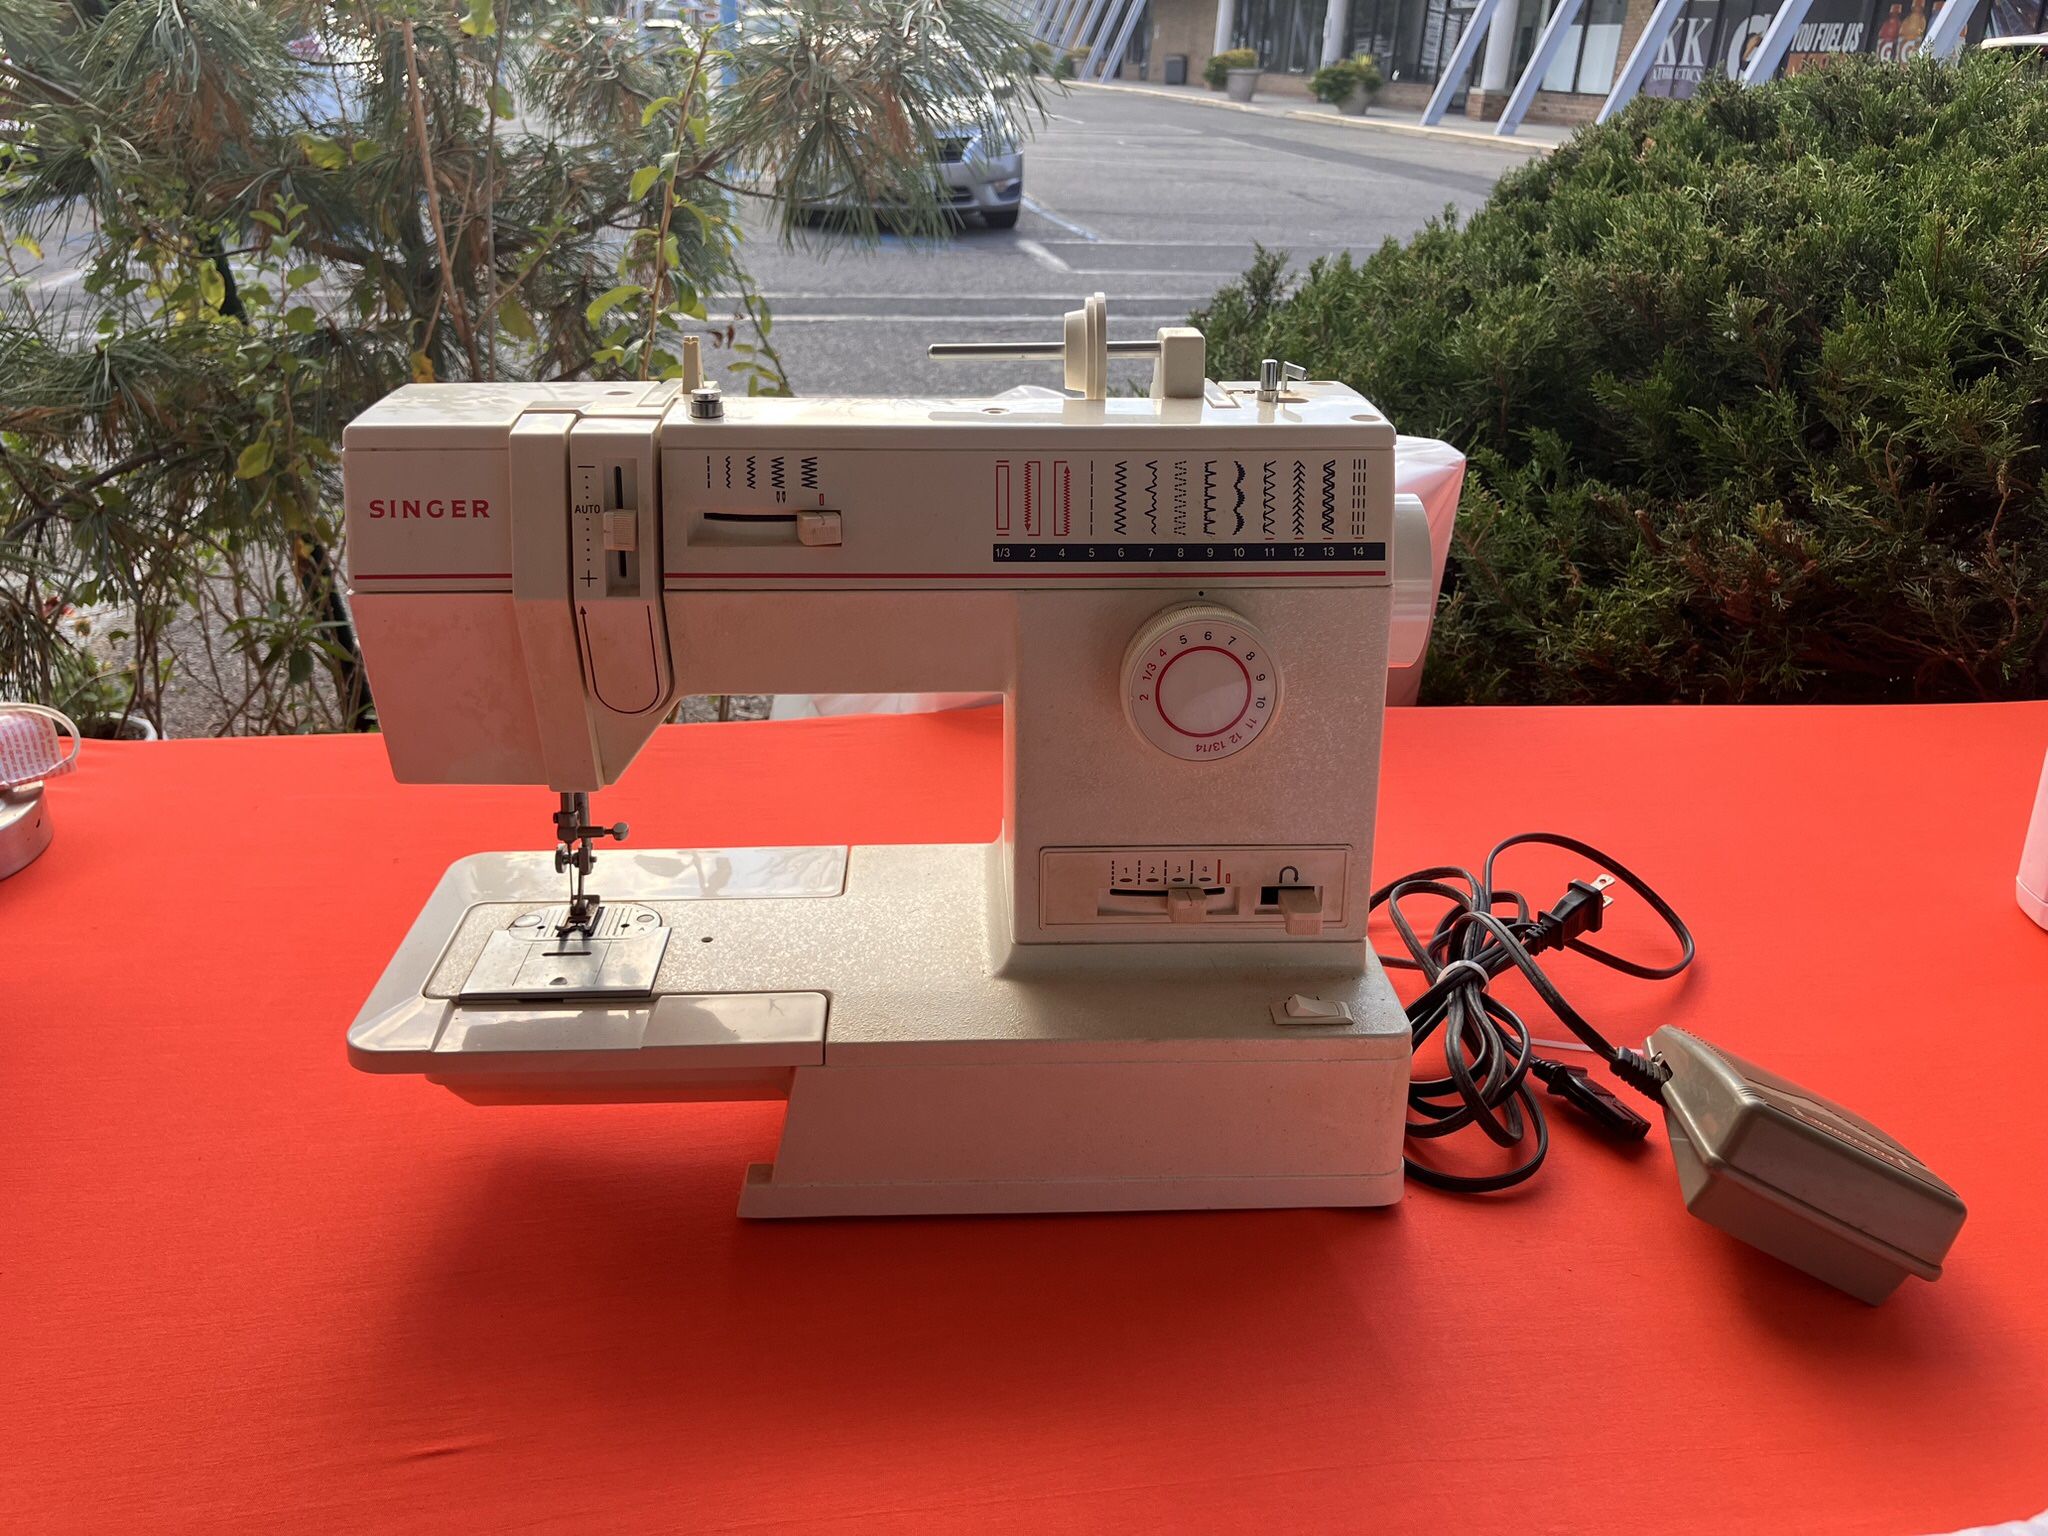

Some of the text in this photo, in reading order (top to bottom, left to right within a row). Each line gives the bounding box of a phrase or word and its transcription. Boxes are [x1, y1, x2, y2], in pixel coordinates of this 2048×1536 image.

[1811, 22, 1845, 53] FUEL
[1842, 22, 1864, 53] US
[369, 499, 490, 519] SINGER
[574, 504, 601, 514] AUTO
[995, 546, 1364, 558] 1/3 2 4 5 6 7 8 9 10 11 12 13 14
[1139, 631, 1266, 753] 2 1/3 4 5 6 7 8 9 10 11 12 13/14
